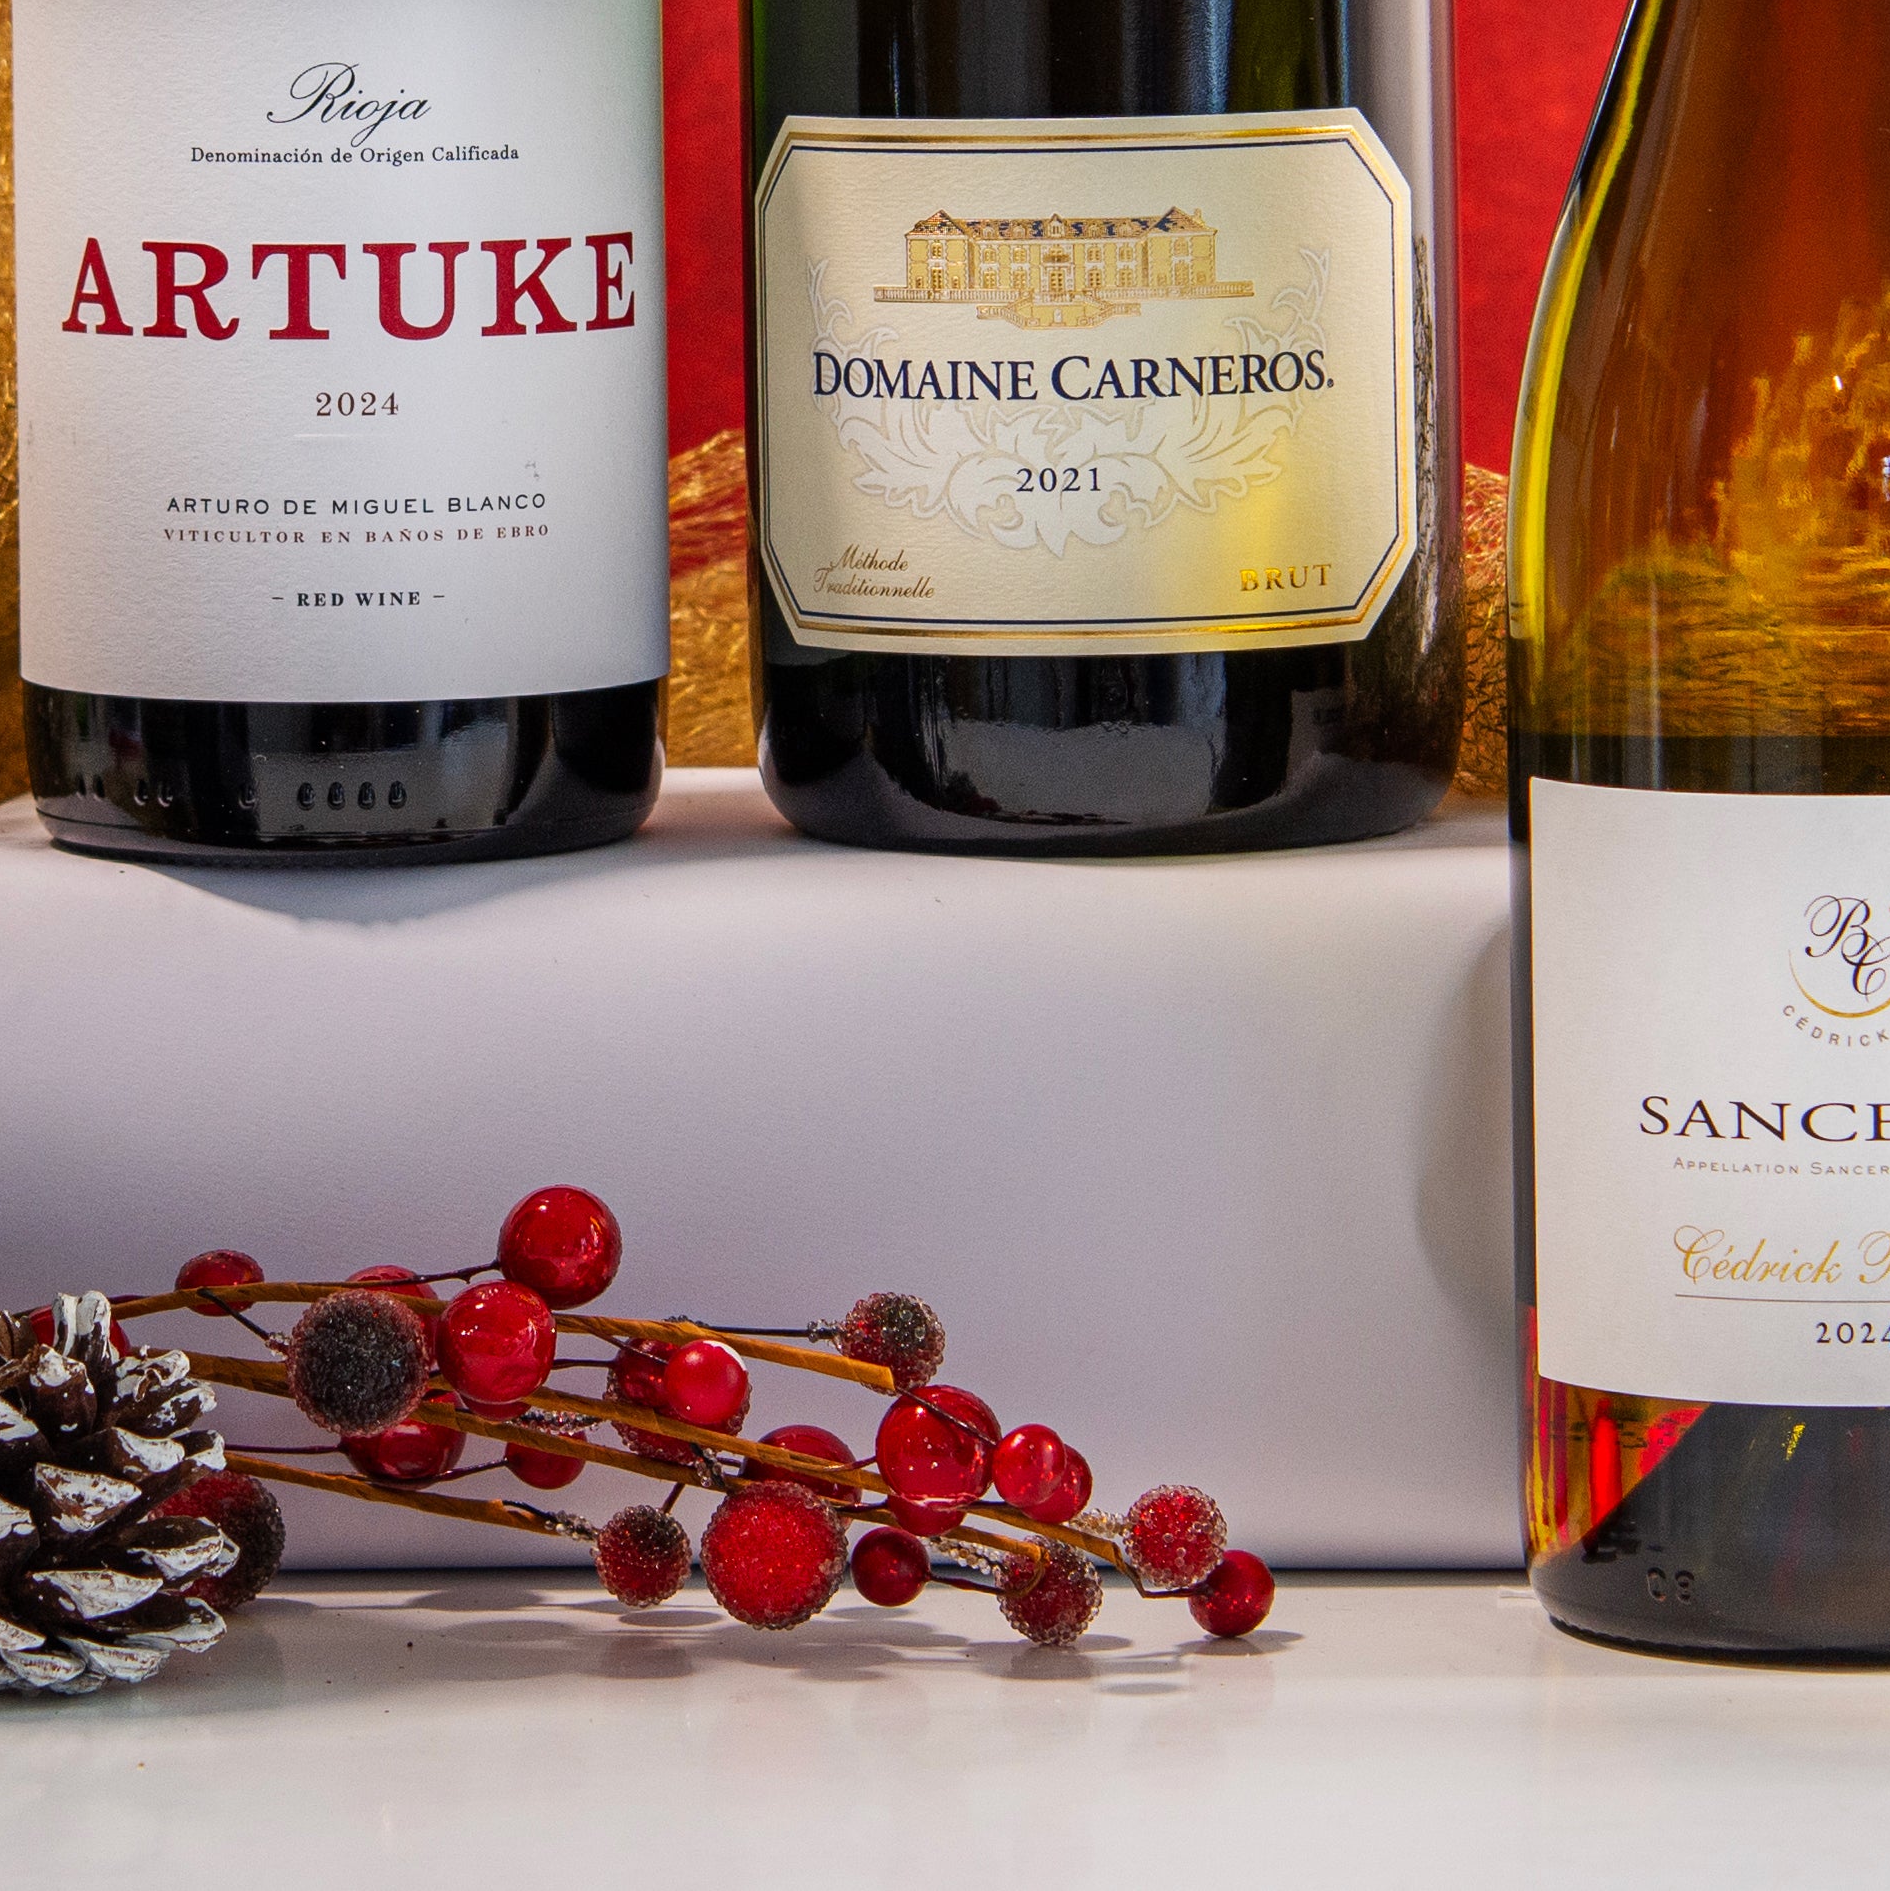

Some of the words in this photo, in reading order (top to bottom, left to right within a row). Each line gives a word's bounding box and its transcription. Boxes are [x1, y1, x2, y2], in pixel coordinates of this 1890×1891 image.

[266, 61, 432, 148] Rioja
[191, 143, 323, 164] Denominación
[330, 146, 353, 163] de
[360, 145, 425, 166] Origen
[432, 143, 519, 163] Calificada
[61, 231, 636, 341] ARTUKE
[813, 352, 1038, 401] DOMAINE
[315, 391, 399, 418] 2024
[1016, 467, 1102, 493] 2021
[167, 497, 270, 516] ARTURO
[283, 499, 318, 516] DE
[331, 497, 434, 516] MIGUEL
[447, 493, 546, 513] BLANCO
[163, 527, 306, 545] VITICULTOR
[321, 529, 351, 545] EN
[365, 524, 445, 543] BAÑOS
[457, 526, 484, 542] DE
[496, 524, 550, 539] EBRO
[829, 543, 909, 572] Méthode
[813, 567, 936, 599] Traditionnelle
[1239, 564, 1333, 593] BRUT
[296, 592, 345, 608] RED
[355, 590, 422, 608] WINE
[1782, 1003, 1890, 1048] CÉDRICK
[1672, 1224, 1843, 1285] Cédrick
